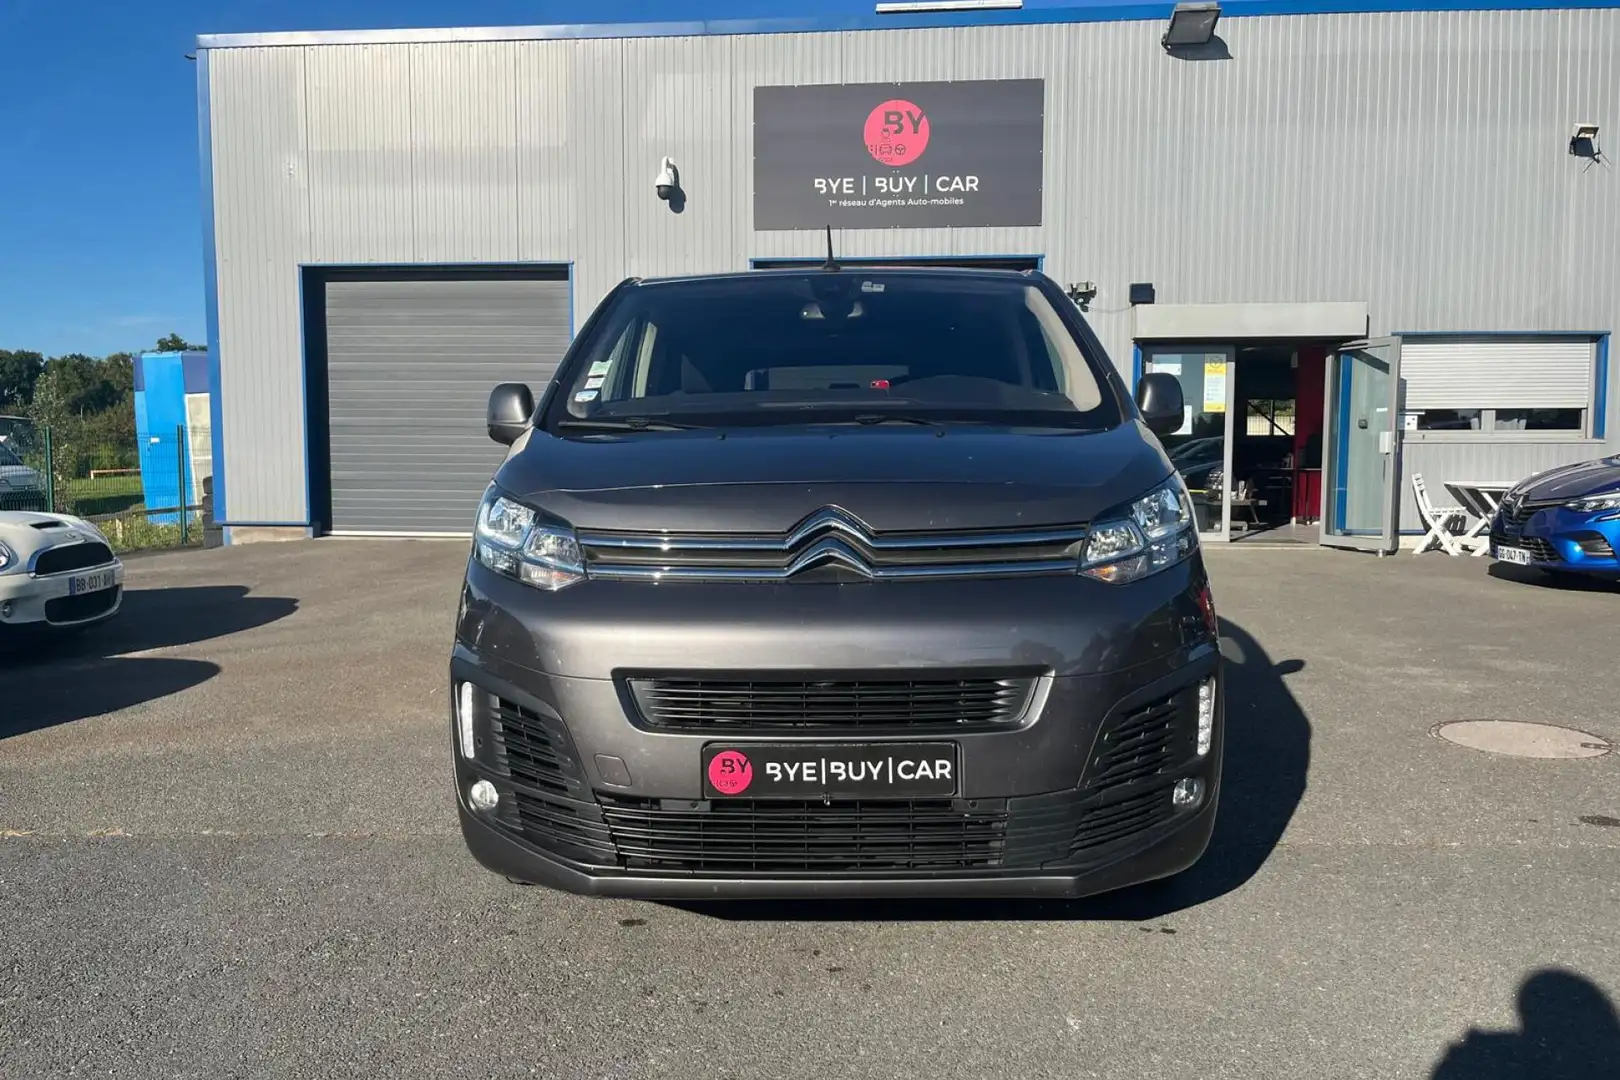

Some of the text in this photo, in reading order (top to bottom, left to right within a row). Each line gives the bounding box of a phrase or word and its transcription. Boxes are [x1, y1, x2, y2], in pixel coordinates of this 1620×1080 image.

[883, 110, 925, 135] BY
[814, 177, 855, 195] BYE
[935, 175, 979, 193] CAR
[839, 198, 867, 207] réseau
[868, 198, 906, 208] d'Agents
[907, 197, 964, 206] Auto-mobiles
[721, 758, 750, 774] BY
